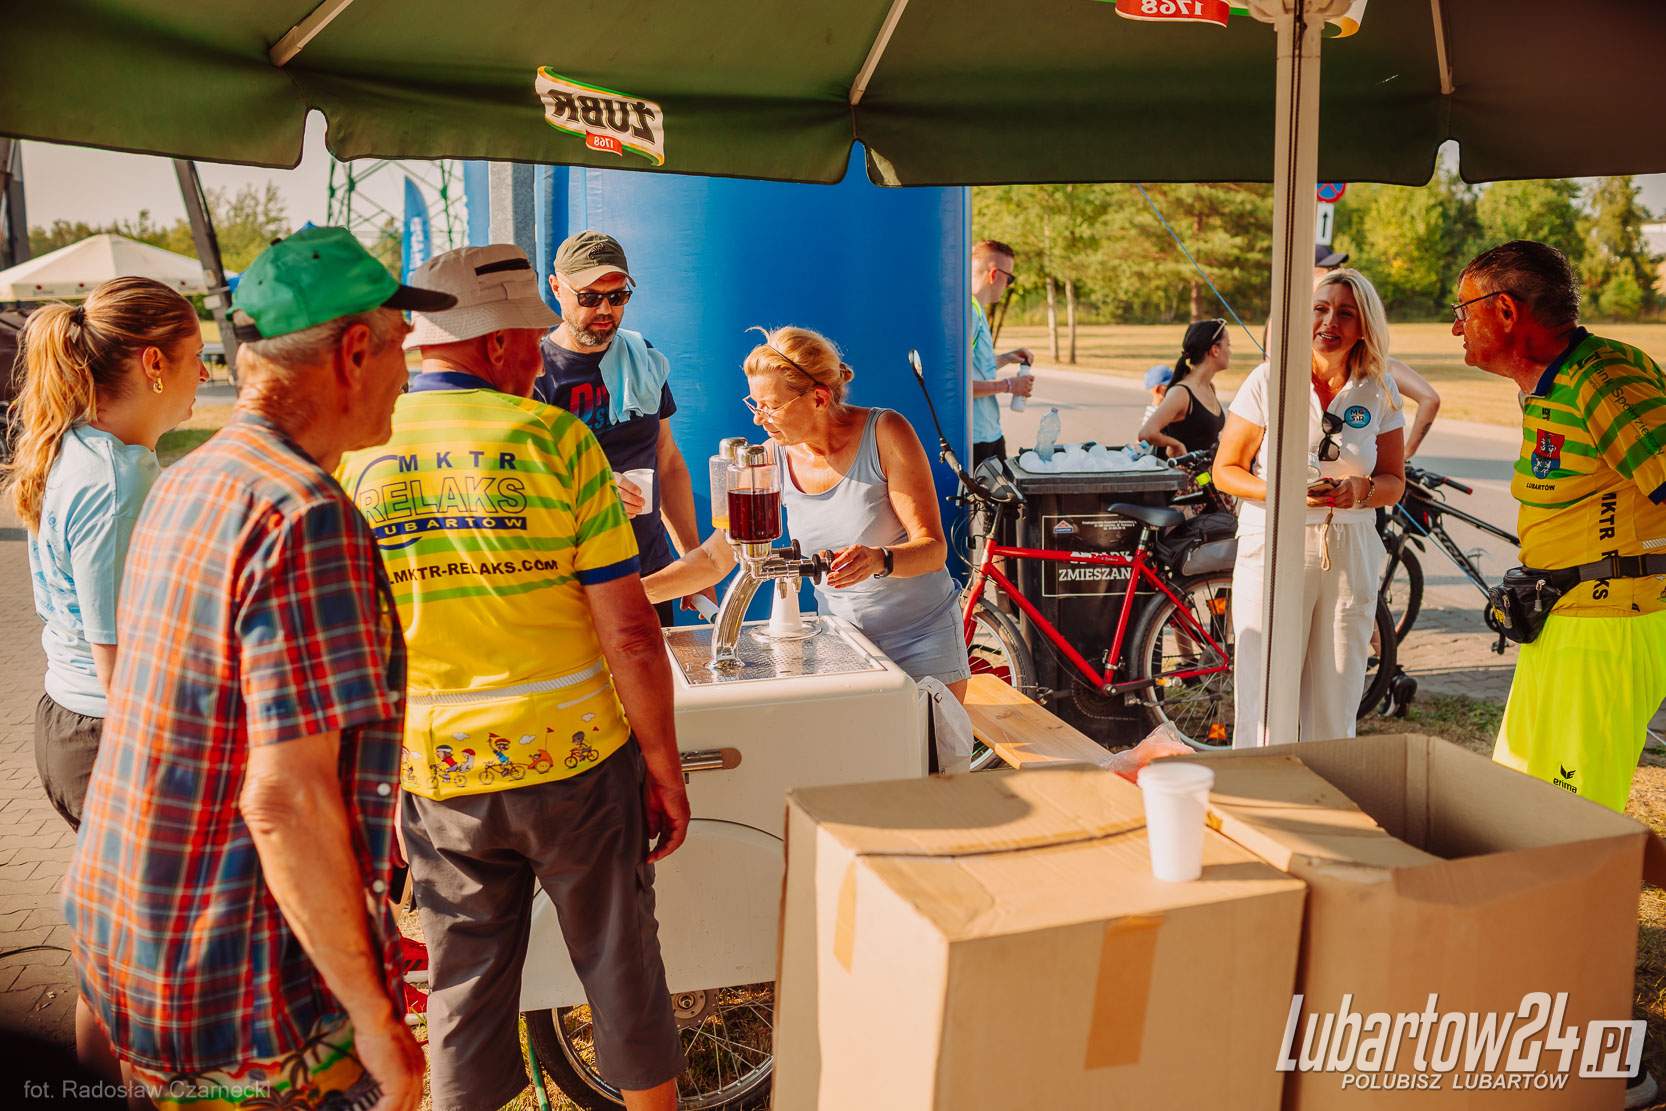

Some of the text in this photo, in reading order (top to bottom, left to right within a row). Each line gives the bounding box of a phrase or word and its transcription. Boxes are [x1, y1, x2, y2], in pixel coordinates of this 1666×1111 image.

[399, 451, 517, 473] MKTR
[359, 476, 528, 524] RELAKS
[375, 516, 523, 538] UBARTÓW
[1059, 567, 1140, 581] ZMIESZAN
[1553, 777, 1577, 793] erima
